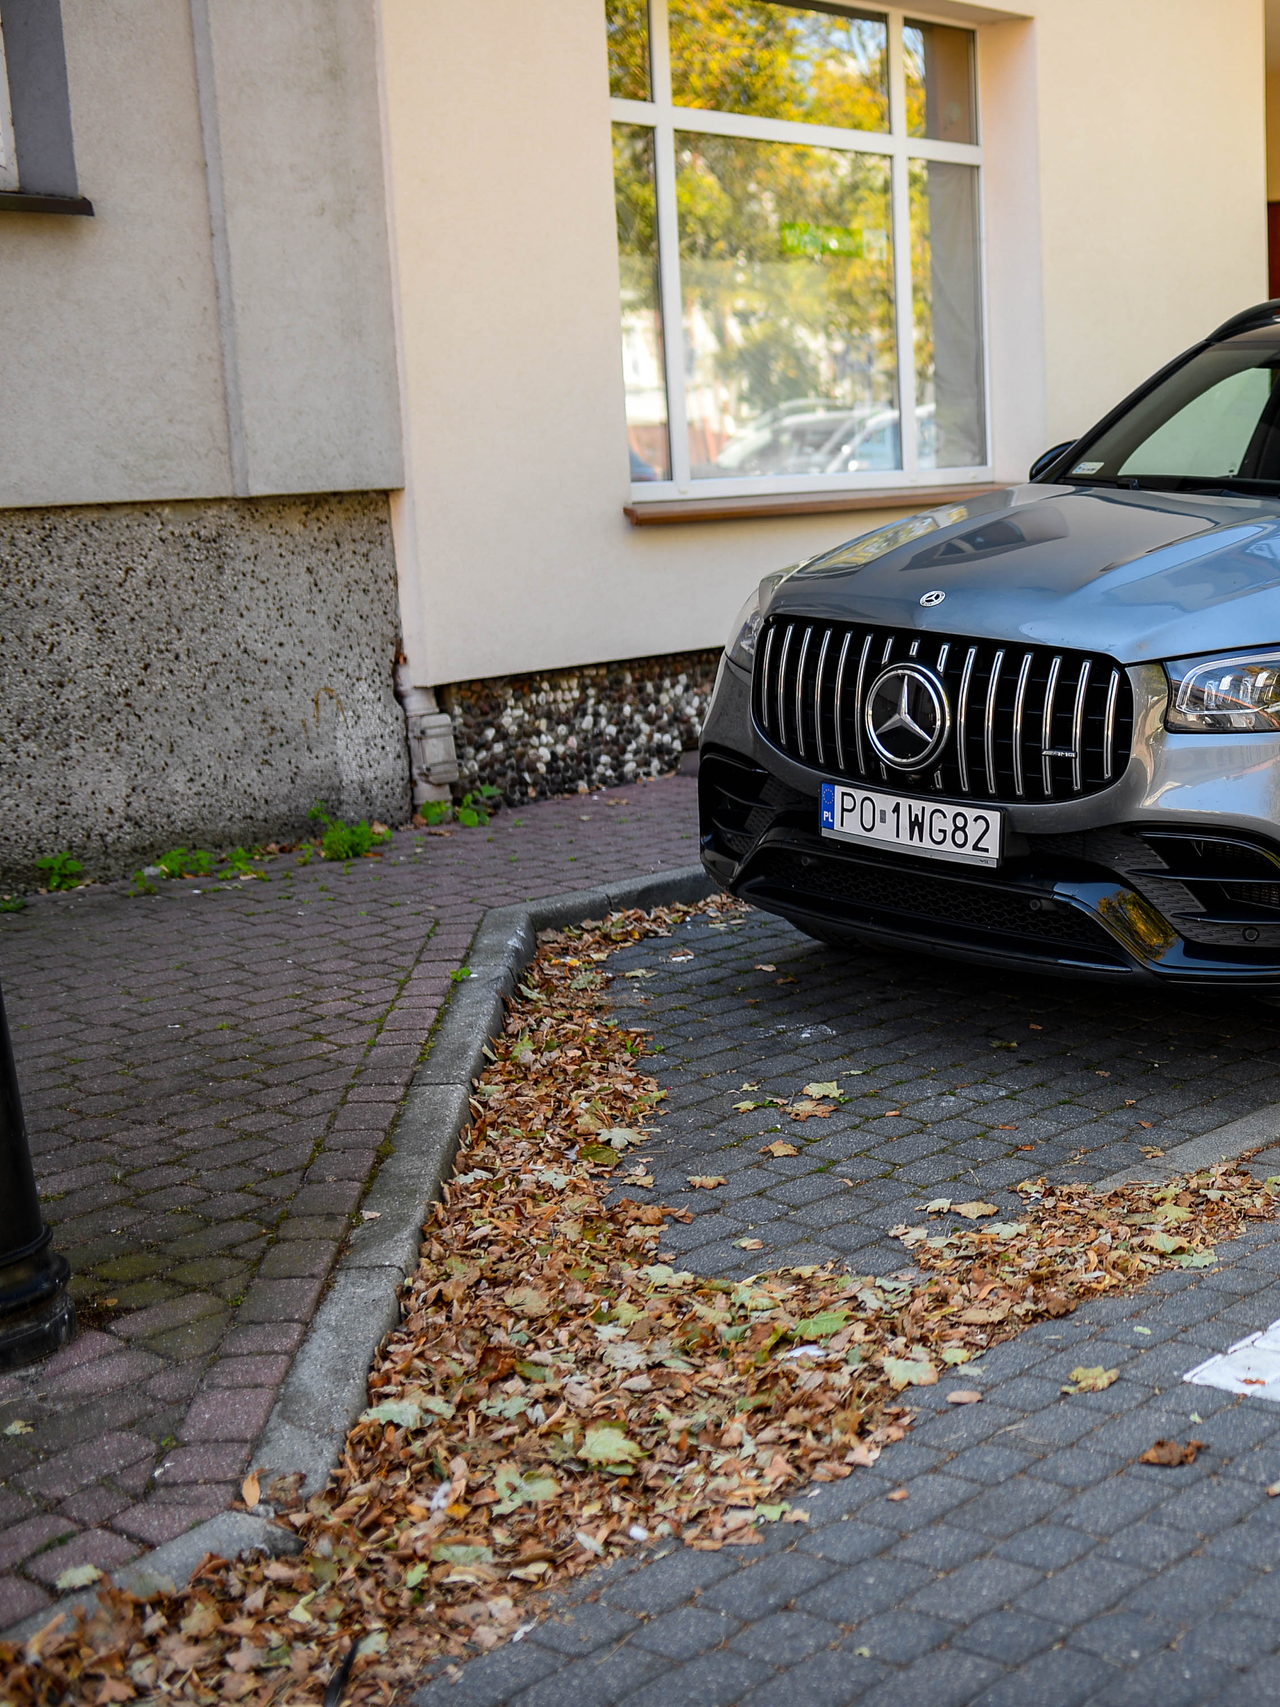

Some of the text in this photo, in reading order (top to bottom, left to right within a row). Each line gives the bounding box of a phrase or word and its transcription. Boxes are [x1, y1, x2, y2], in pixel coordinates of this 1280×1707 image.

[823, 811, 833, 822] PL
[840, 792, 990, 853] PO 1WG82
